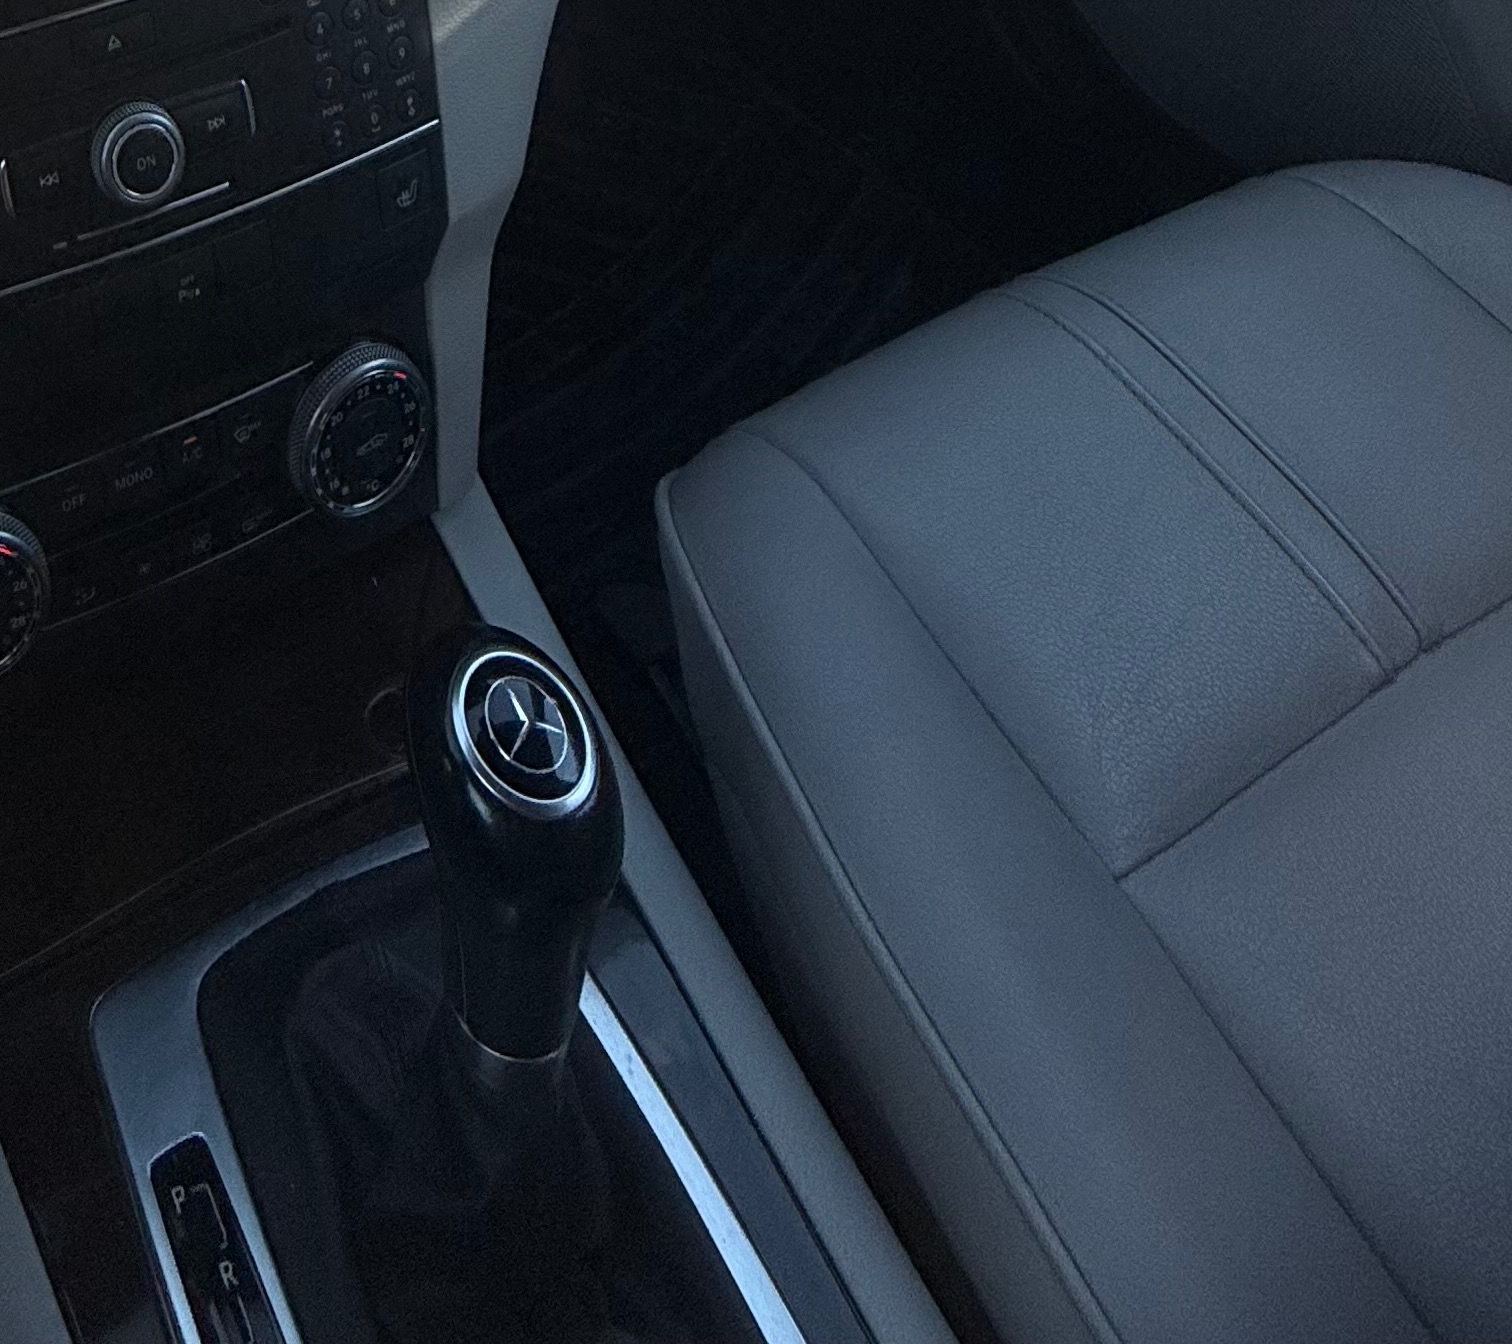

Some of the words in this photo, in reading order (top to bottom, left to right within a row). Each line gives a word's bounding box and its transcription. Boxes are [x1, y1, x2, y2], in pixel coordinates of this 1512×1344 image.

[135, 153, 157, 172] ON
[114, 465, 154, 491] MONO
[61, 492, 88, 512] OFF
[171, 1184, 185, 1214] P
[218, 1260, 239, 1290] R
